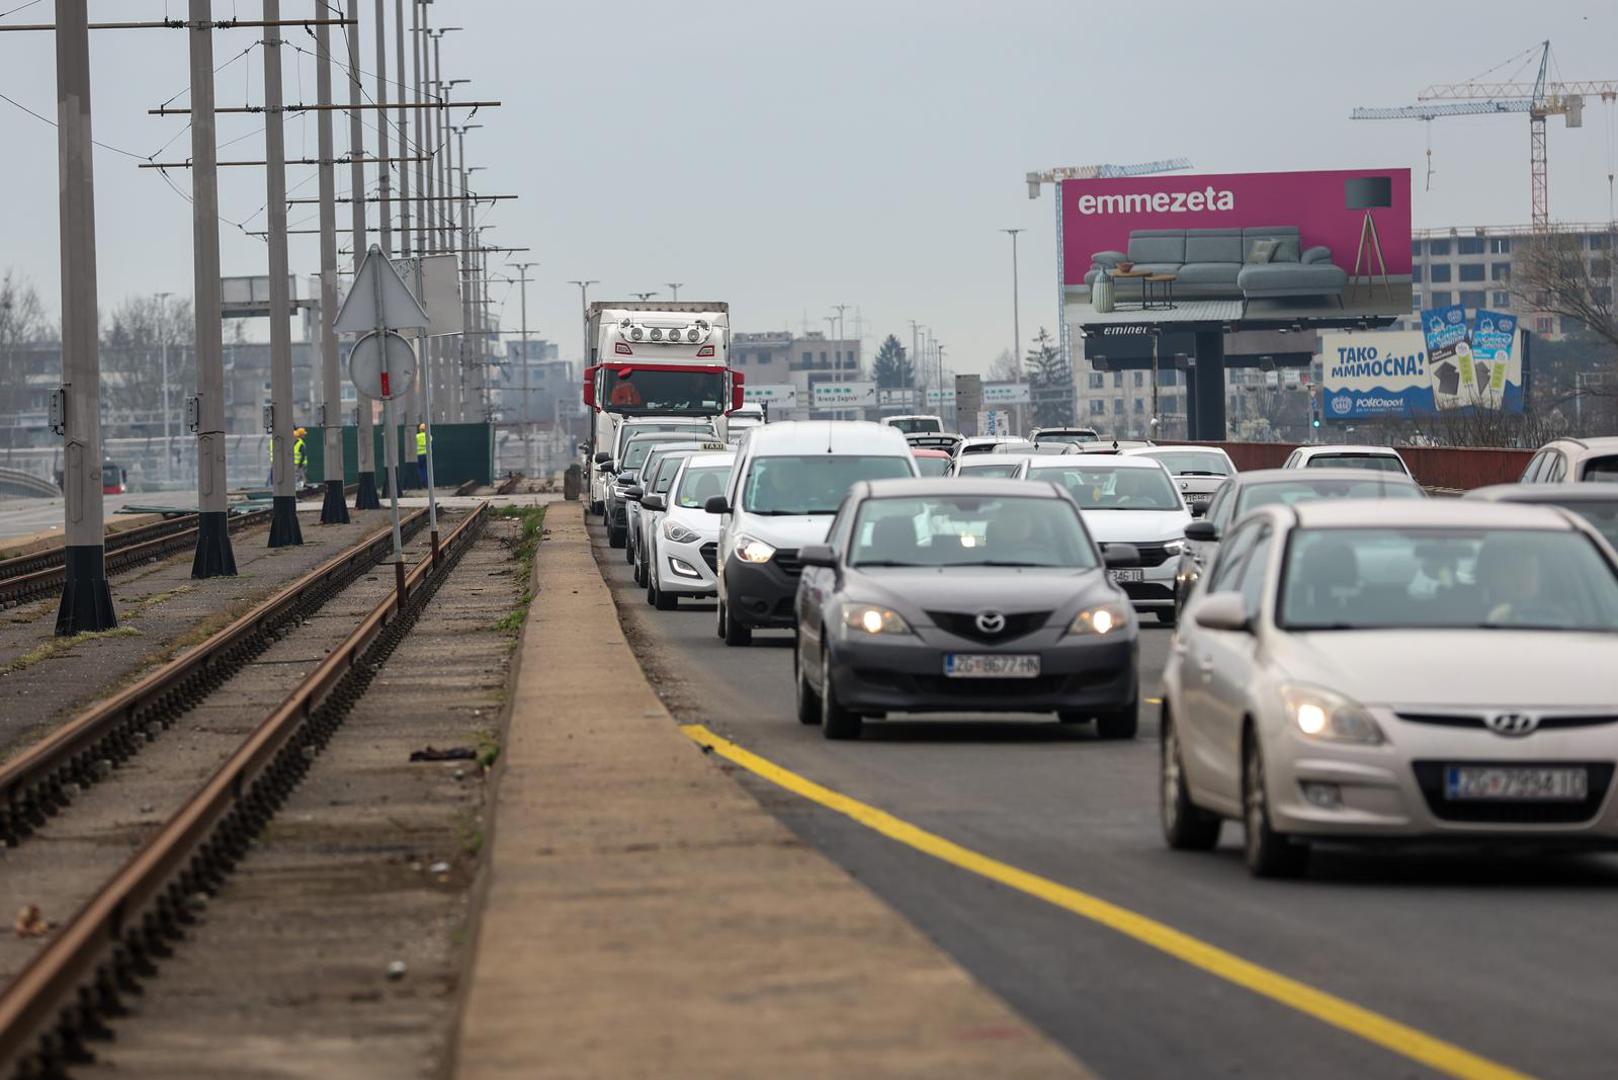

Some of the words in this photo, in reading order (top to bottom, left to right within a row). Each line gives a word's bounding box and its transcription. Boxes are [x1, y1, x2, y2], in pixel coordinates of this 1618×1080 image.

[1078, 186, 1234, 215] emmezeta
[1331, 352, 1425, 377] MMMOĆNA!
[1337, 347, 1378, 364] TAKO
